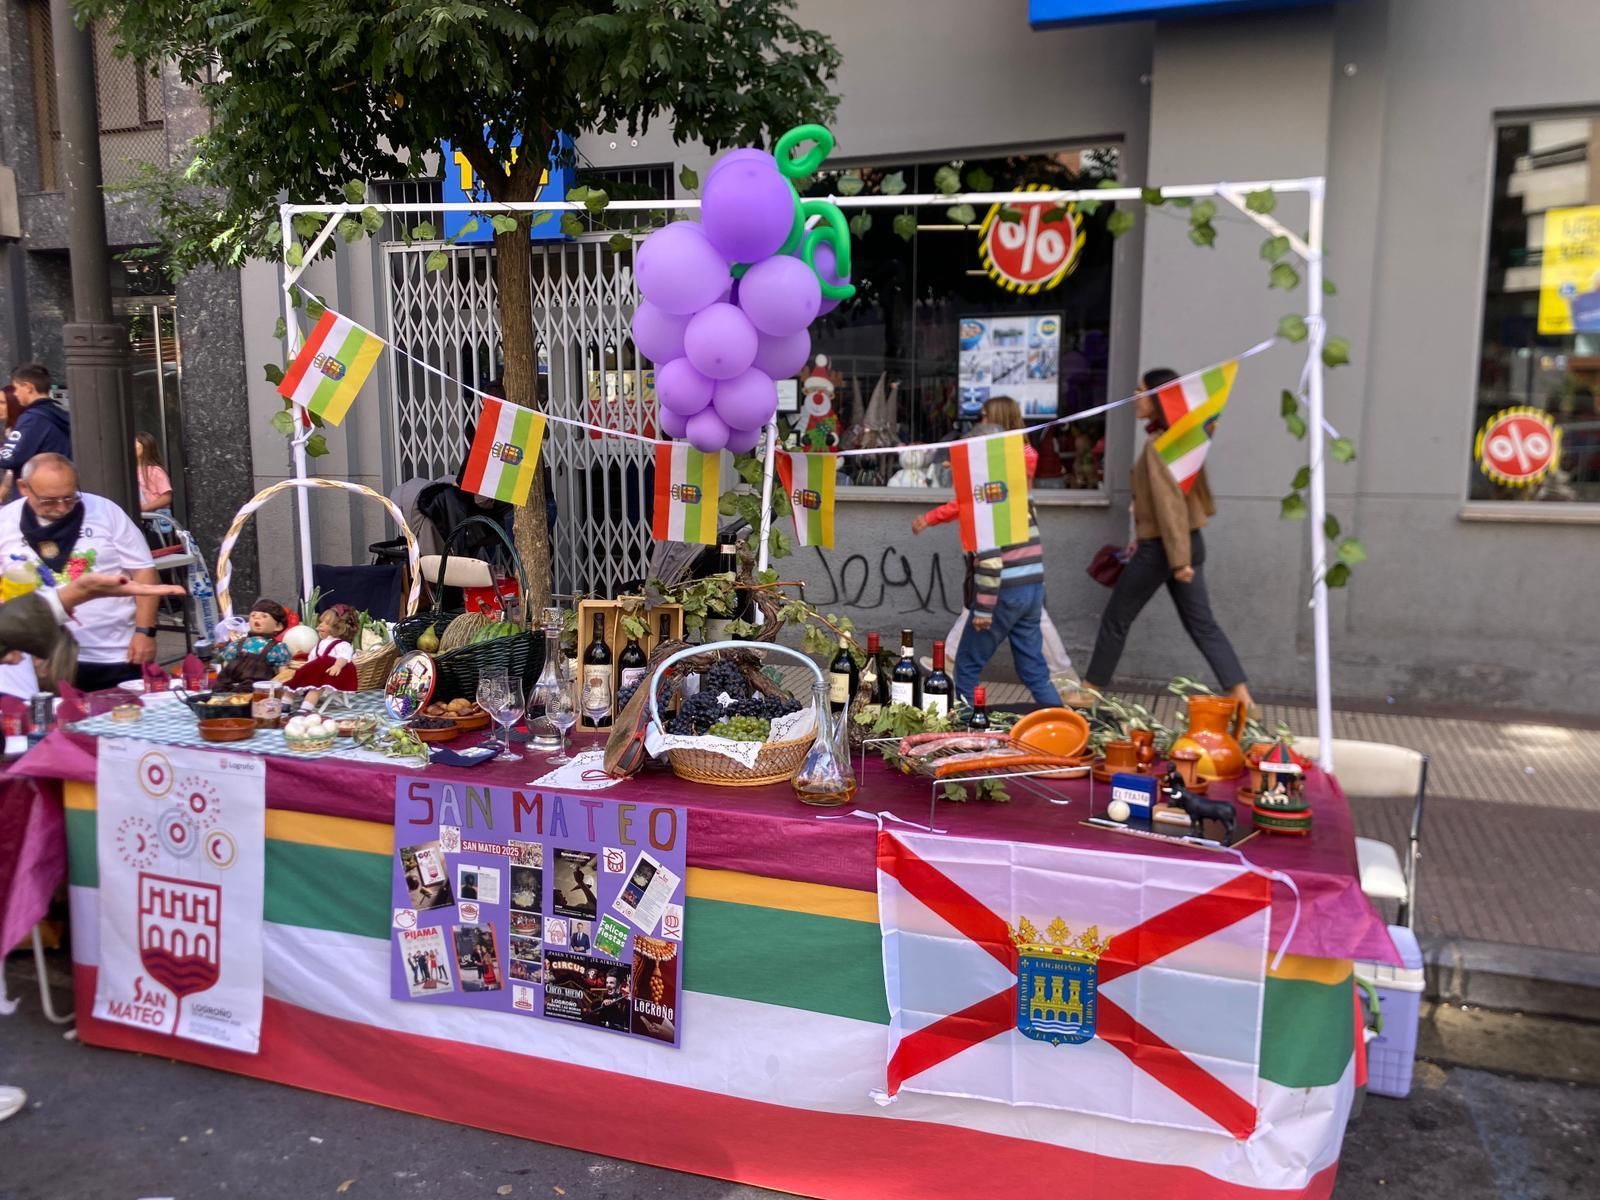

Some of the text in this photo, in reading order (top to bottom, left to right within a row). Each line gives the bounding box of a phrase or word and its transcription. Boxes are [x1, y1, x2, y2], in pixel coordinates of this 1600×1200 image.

[408, 782, 678, 852] SAN MATEO
[462, 841, 477, 852] SAN
[478, 843, 501, 855] MATEO
[501, 845, 520, 857] 2025
[404, 927, 438, 940] PIJAMA
[551, 961, 586, 975] CIRCUS
[133, 976, 168, 1009] SAN
[107, 1000, 165, 1026] MATEO
[191, 1003, 232, 1019] LOGROÑO
[634, 999, 674, 1021] LOGROÑO
